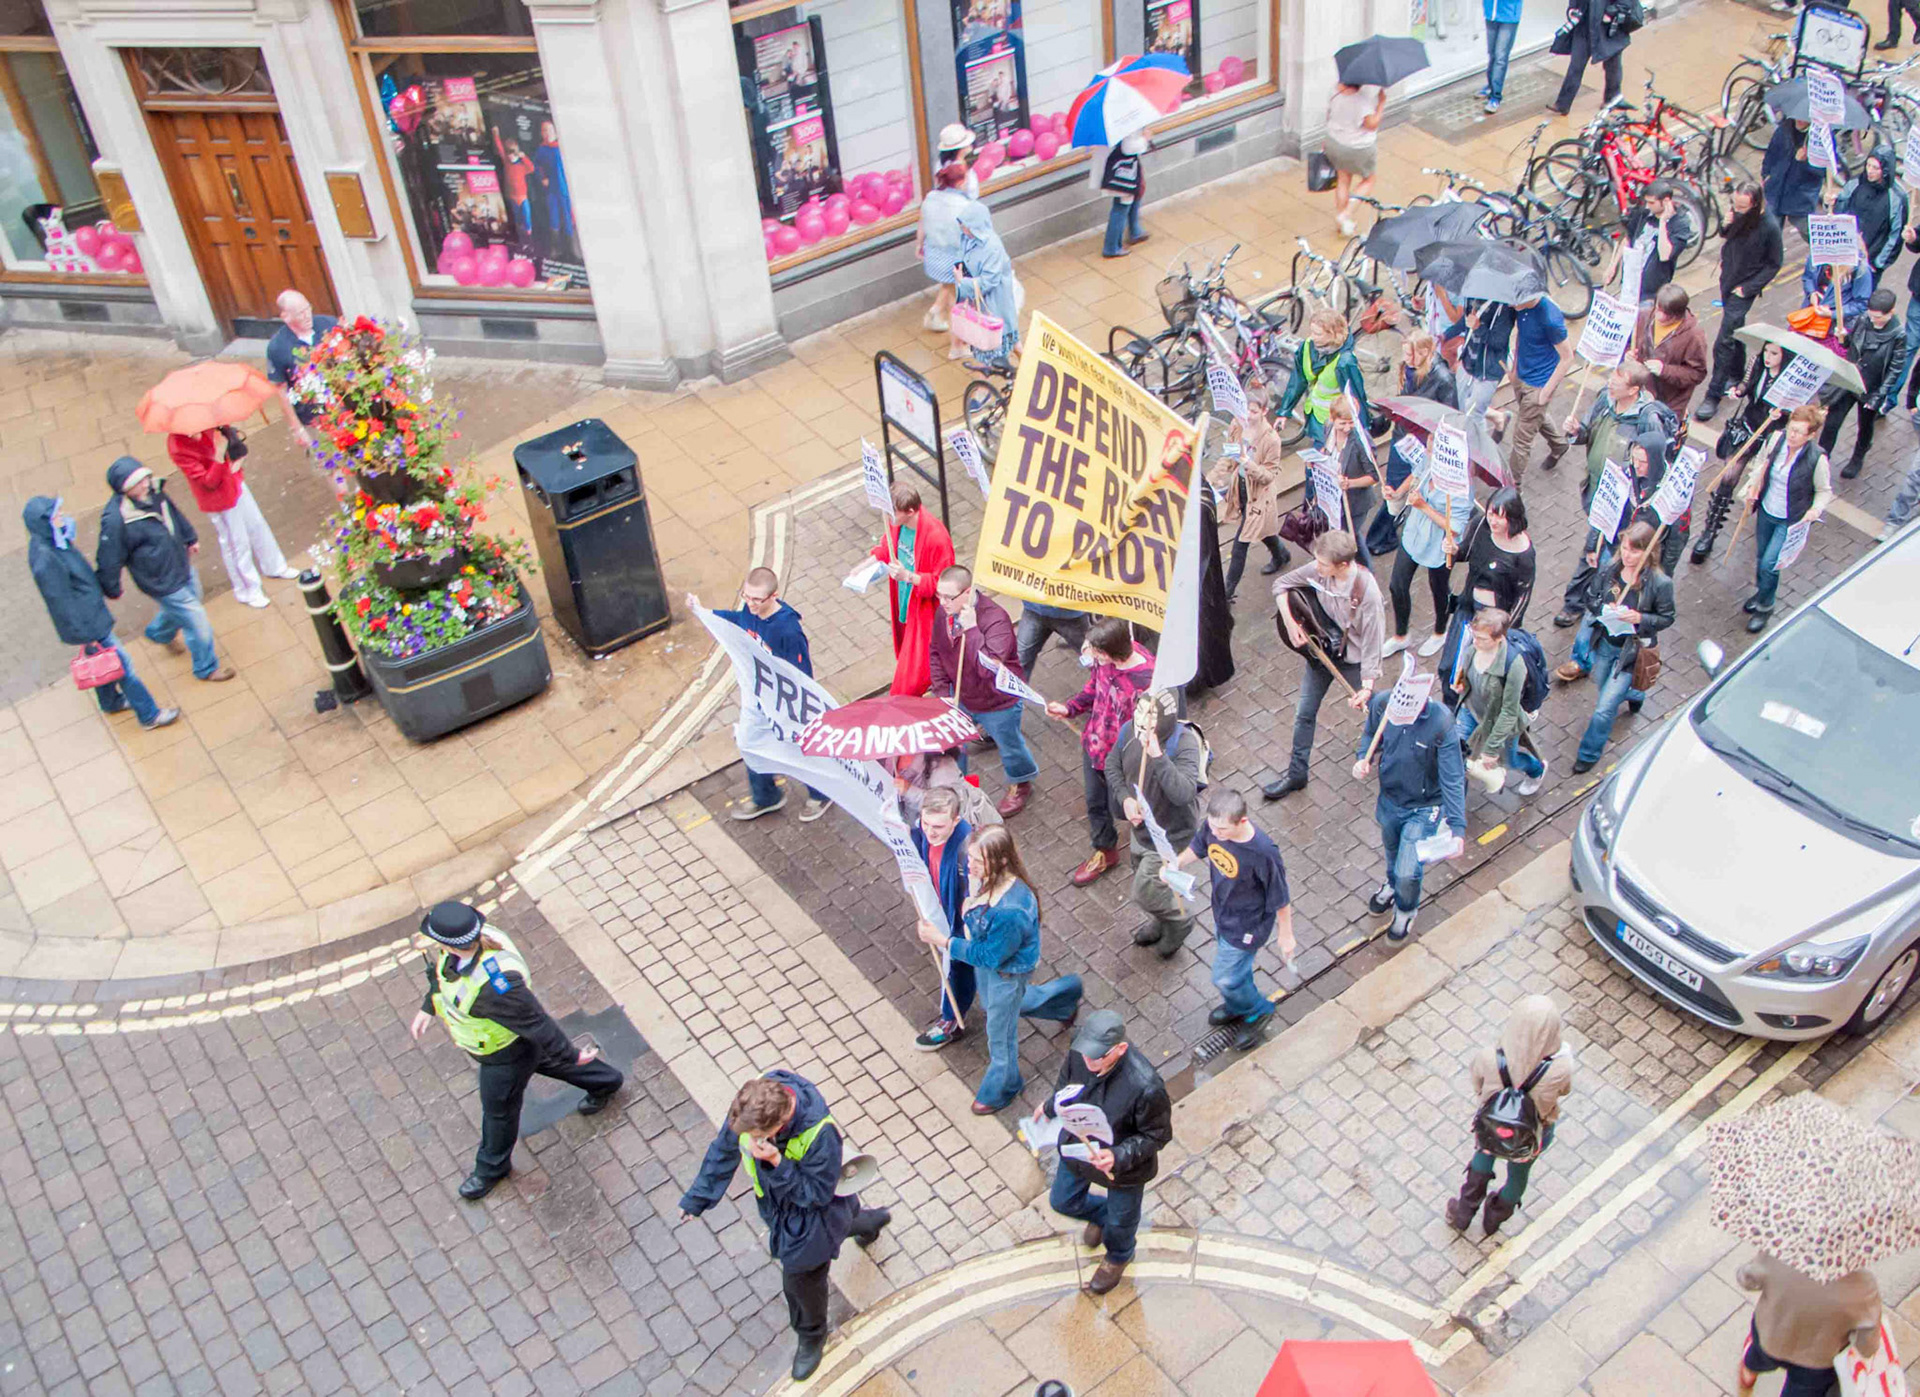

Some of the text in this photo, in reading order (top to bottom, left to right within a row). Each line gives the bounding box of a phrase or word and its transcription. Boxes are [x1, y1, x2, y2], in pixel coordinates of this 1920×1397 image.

[1809, 84, 1836, 97] FRANK
[1811, 223, 1837, 231] FREE
[1811, 230, 1848, 238] FRANK
[1812, 238, 1853, 246] FERNIE!
[1594, 300, 1616, 319] FREE
[1590, 310, 1623, 331] FRANK
[1587, 320, 1624, 342] FERNIE!
[1789, 363, 1820, 382] FRANK
[1797, 354, 1820, 373] FREE
[1783, 371, 1816, 391] FERNIE!
[1026, 360, 1147, 482] DEFEND
[863, 454, 878, 466] REE
[1016, 424, 1090, 512] THE
[1435, 453, 1465, 470] ERNIE!
[1000, 487, 1178, 593] TO PROT
[753, 655, 833, 726] FRE
[1667, 959, 1699, 986] CZW
